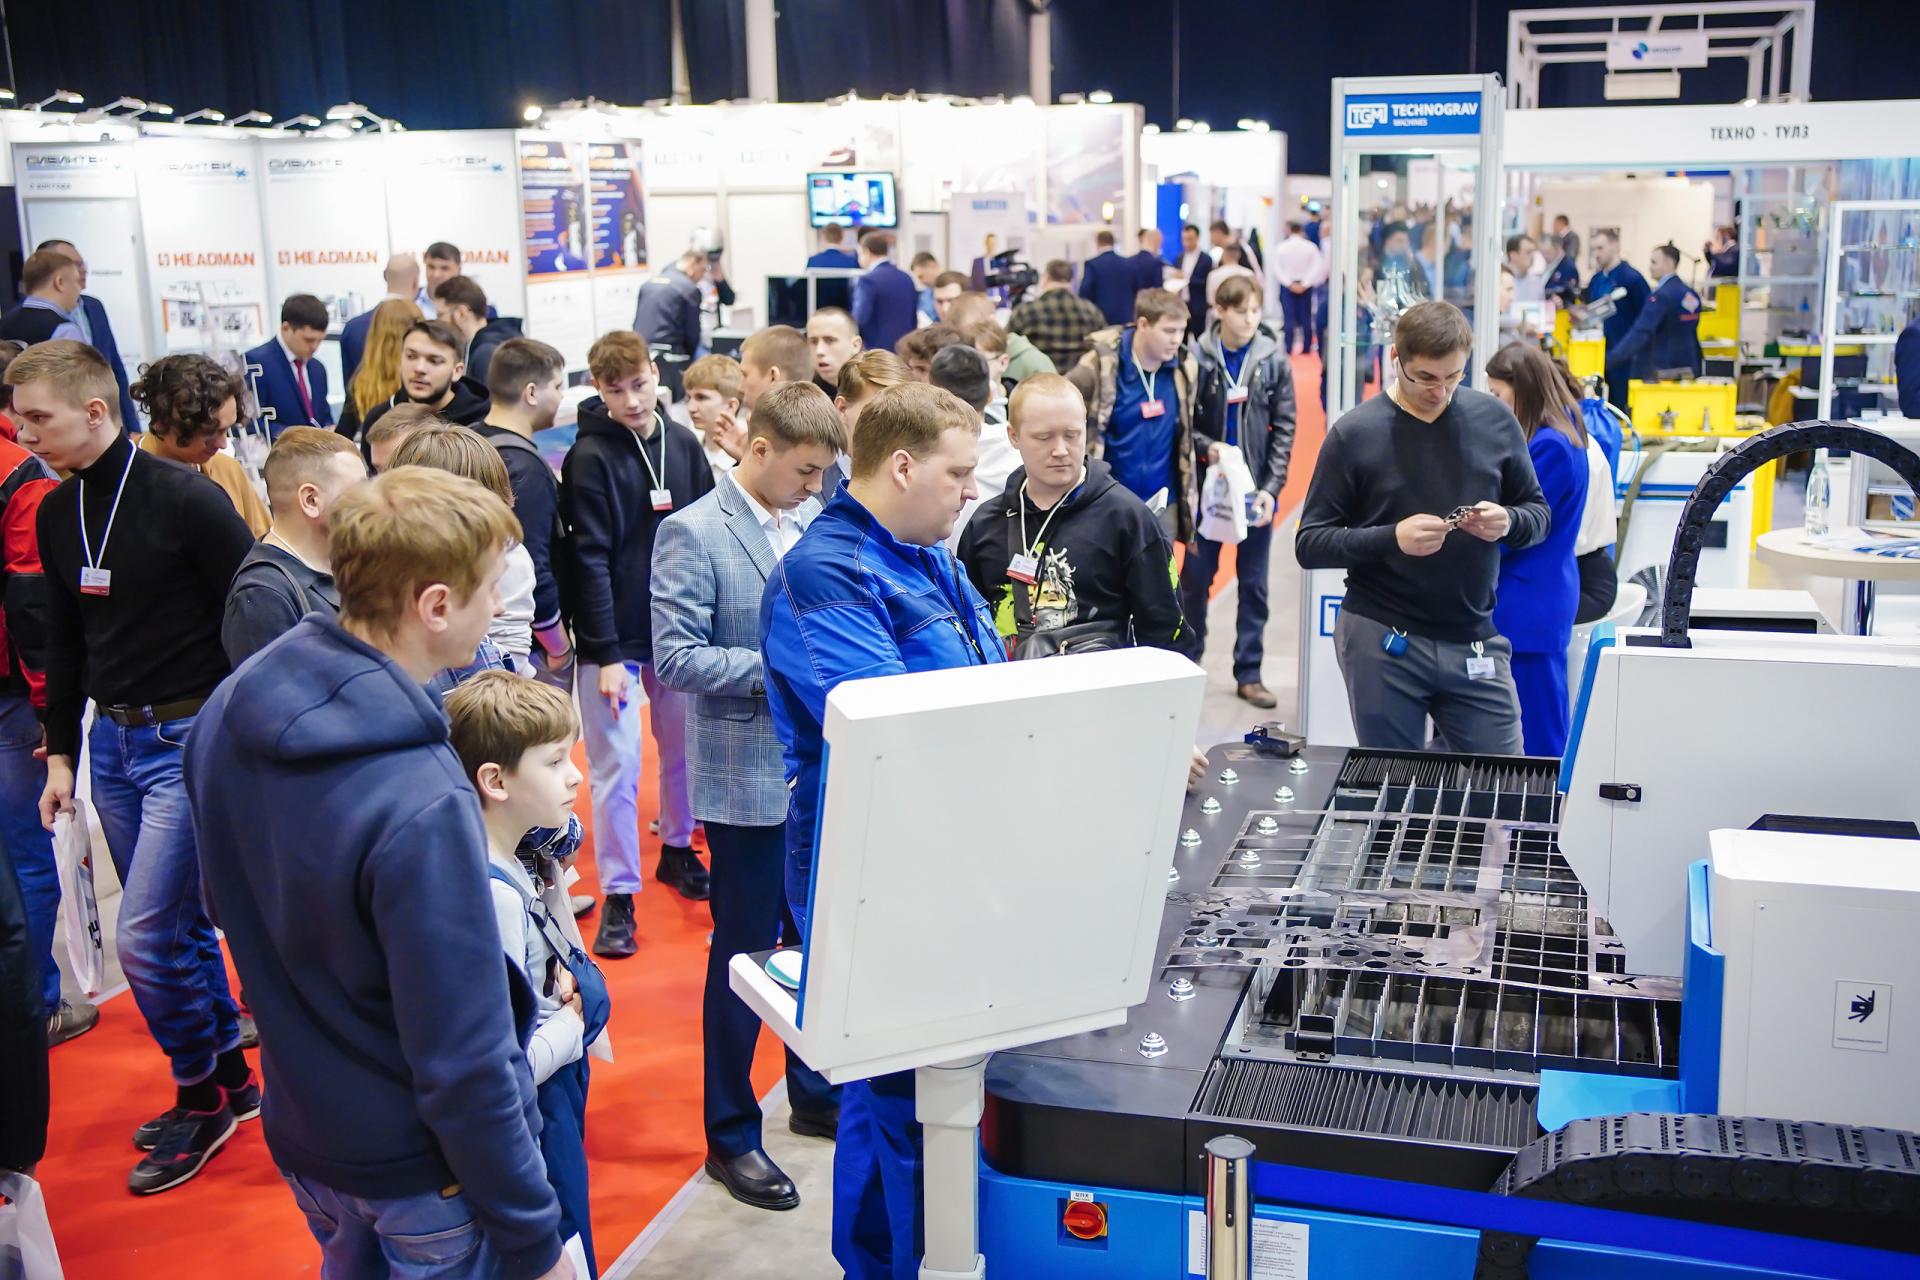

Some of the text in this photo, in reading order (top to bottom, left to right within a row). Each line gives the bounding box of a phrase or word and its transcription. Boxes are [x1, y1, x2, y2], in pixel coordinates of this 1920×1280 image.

[1349, 102, 1478, 126] TGM TECHNOGRAV
[1711, 127, 1755, 140] ТЕХНО
[1776, 125, 1809, 139] ТУЛЗ
[173, 253, 256, 266] HEADMAN
[294, 251, 378, 265] HEADMAN
